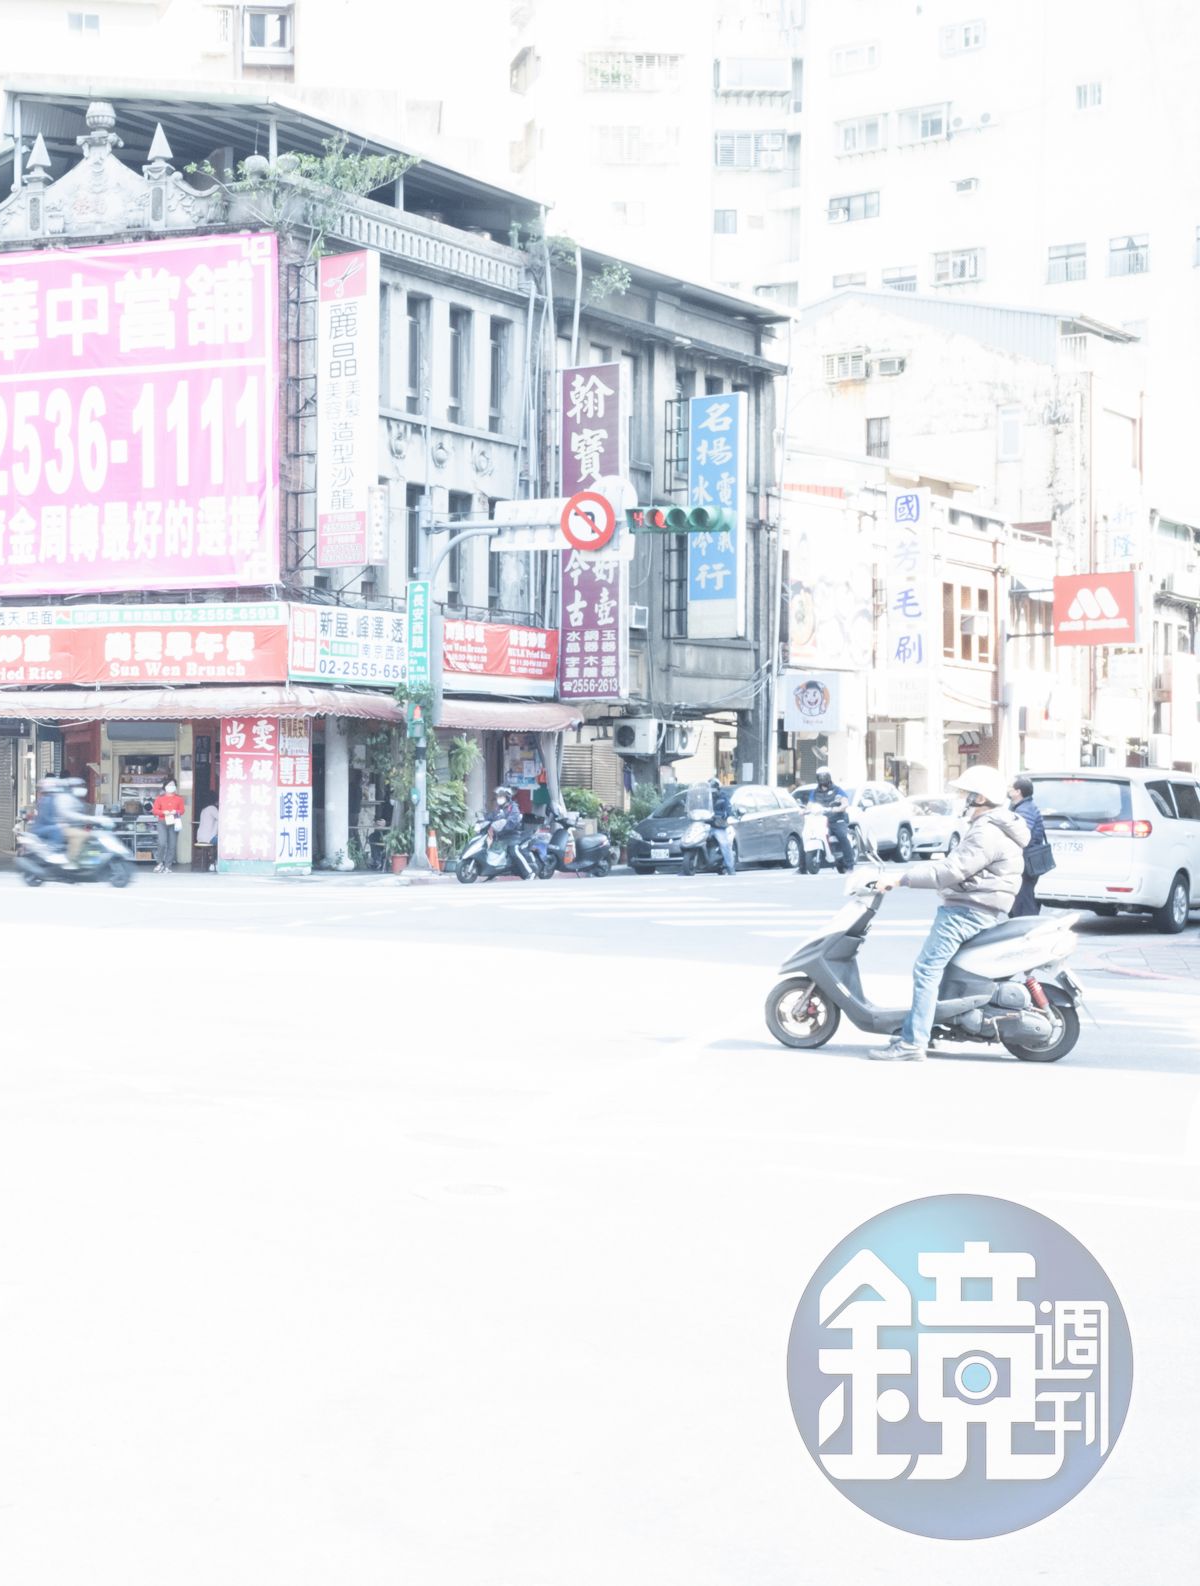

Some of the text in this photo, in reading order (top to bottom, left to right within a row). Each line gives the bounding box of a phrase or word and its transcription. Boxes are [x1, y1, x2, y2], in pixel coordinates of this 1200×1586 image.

[29, 667, 62, 680] Rice
[110, 661, 246, 677] Sun Wen Brunch
